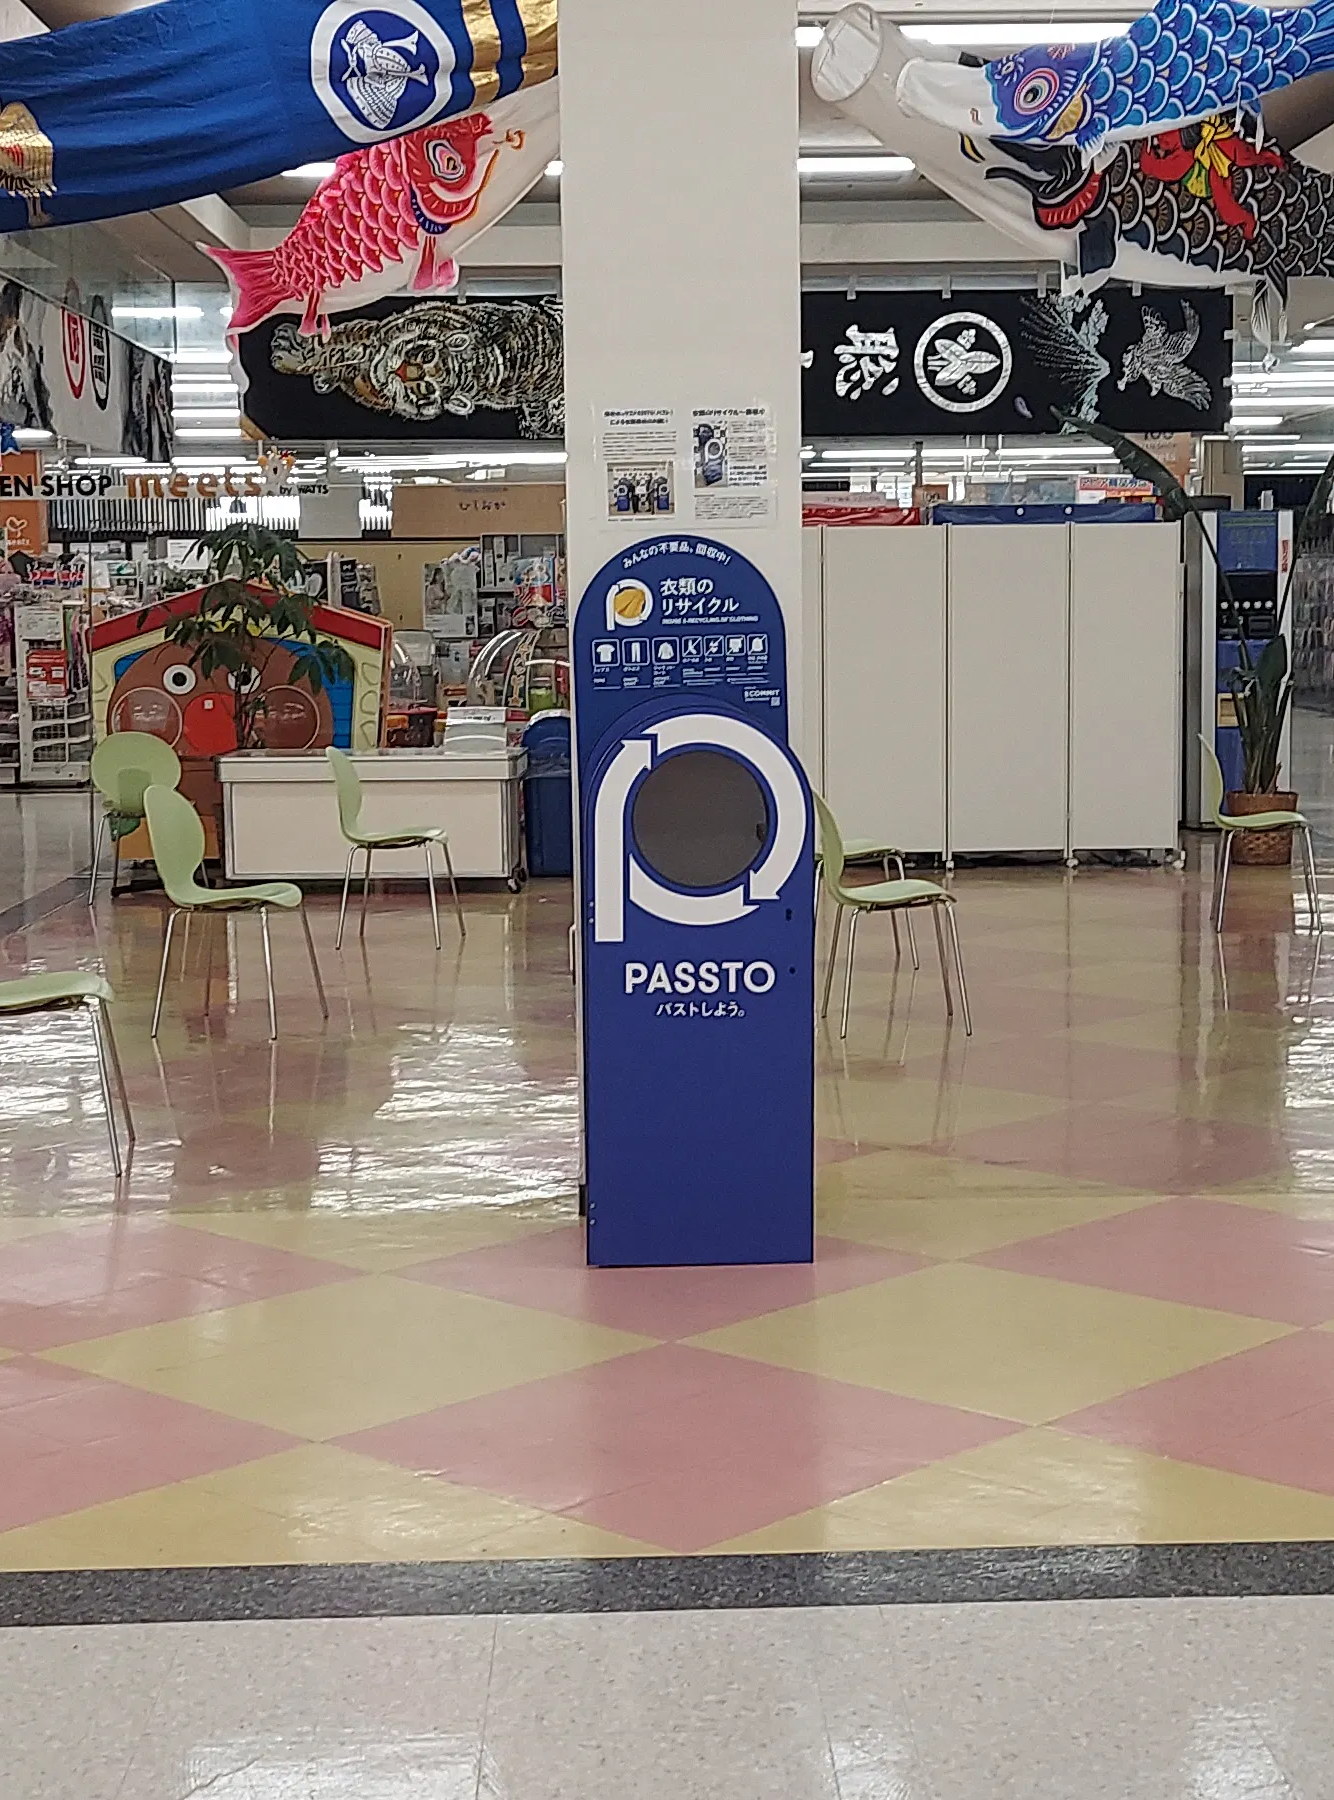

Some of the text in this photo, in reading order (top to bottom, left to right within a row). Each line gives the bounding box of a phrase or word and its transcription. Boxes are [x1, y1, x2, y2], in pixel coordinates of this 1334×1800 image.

[40, 475, 112, 497] SHOP
[125, 471, 262, 498] meets
[660, 577, 714, 597] 衣類の
[662, 597, 740, 616] リサイクル
[625, 961, 776, 994] PASSTO
[656, 1001, 745, 1017] パストしよう。
